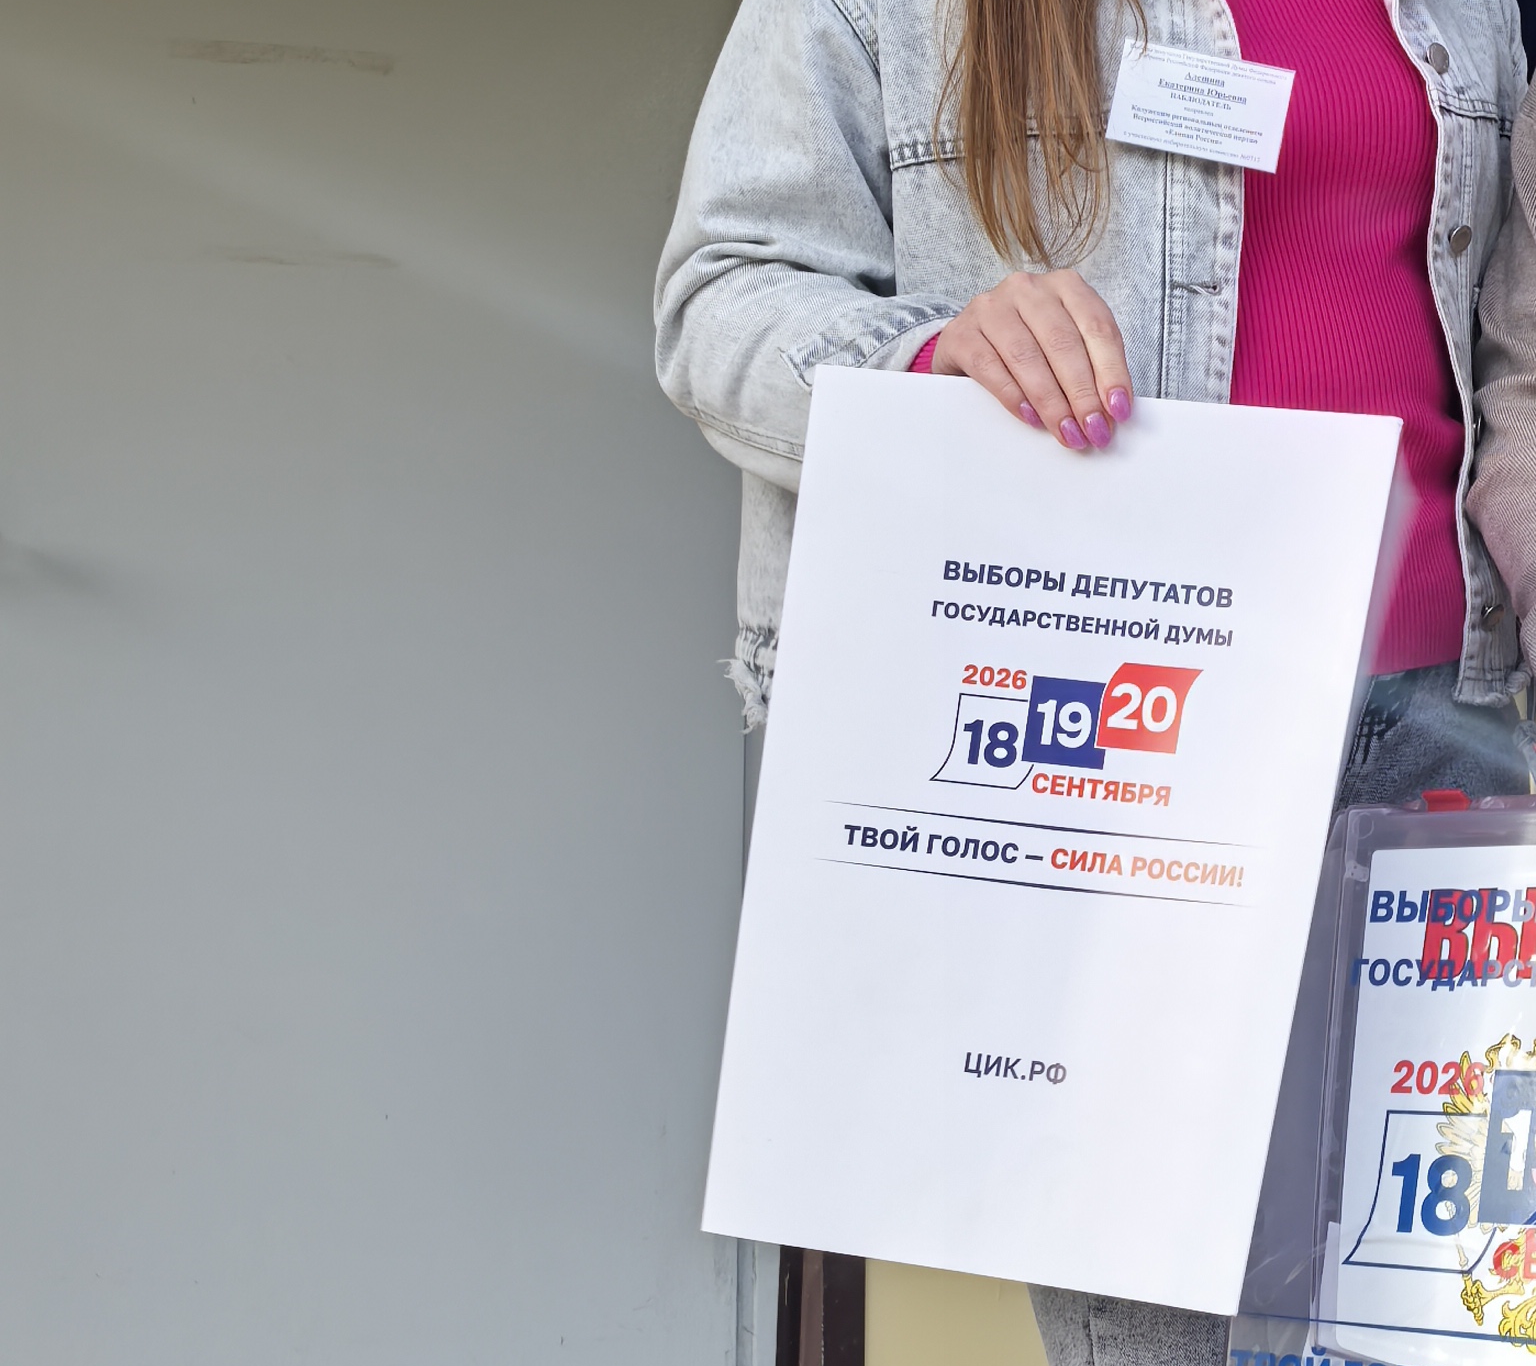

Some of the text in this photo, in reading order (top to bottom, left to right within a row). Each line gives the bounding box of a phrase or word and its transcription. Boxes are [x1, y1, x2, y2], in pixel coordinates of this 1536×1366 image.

[1170, 92, 1232, 110] НАБЛЮДАТЕЛЬ
[943, 560, 1233, 608] ВЫБОРЫ ДЕПУТАТОВ
[931, 600, 1233, 647] ГОСУДАРСТВЕННОЙ ДУМЫ
[962, 664, 1027, 690] 2026
[963, 682, 1177, 768] 18 19 20
[1032, 773, 1170, 806] СЕНТЯБРЯ
[844, 824, 919, 852] ТВОЙ
[927, 834, 1018, 864] ГОЛОС
[1050, 848, 1123, 875] СИЛА
[1130, 862, 1244, 887] РОССИИ!
[964, 1052, 1067, 1085] ЦИК.РФ
[1390, 1060, 1485, 1096] 2026
[1392, 1154, 1473, 1236] 18
